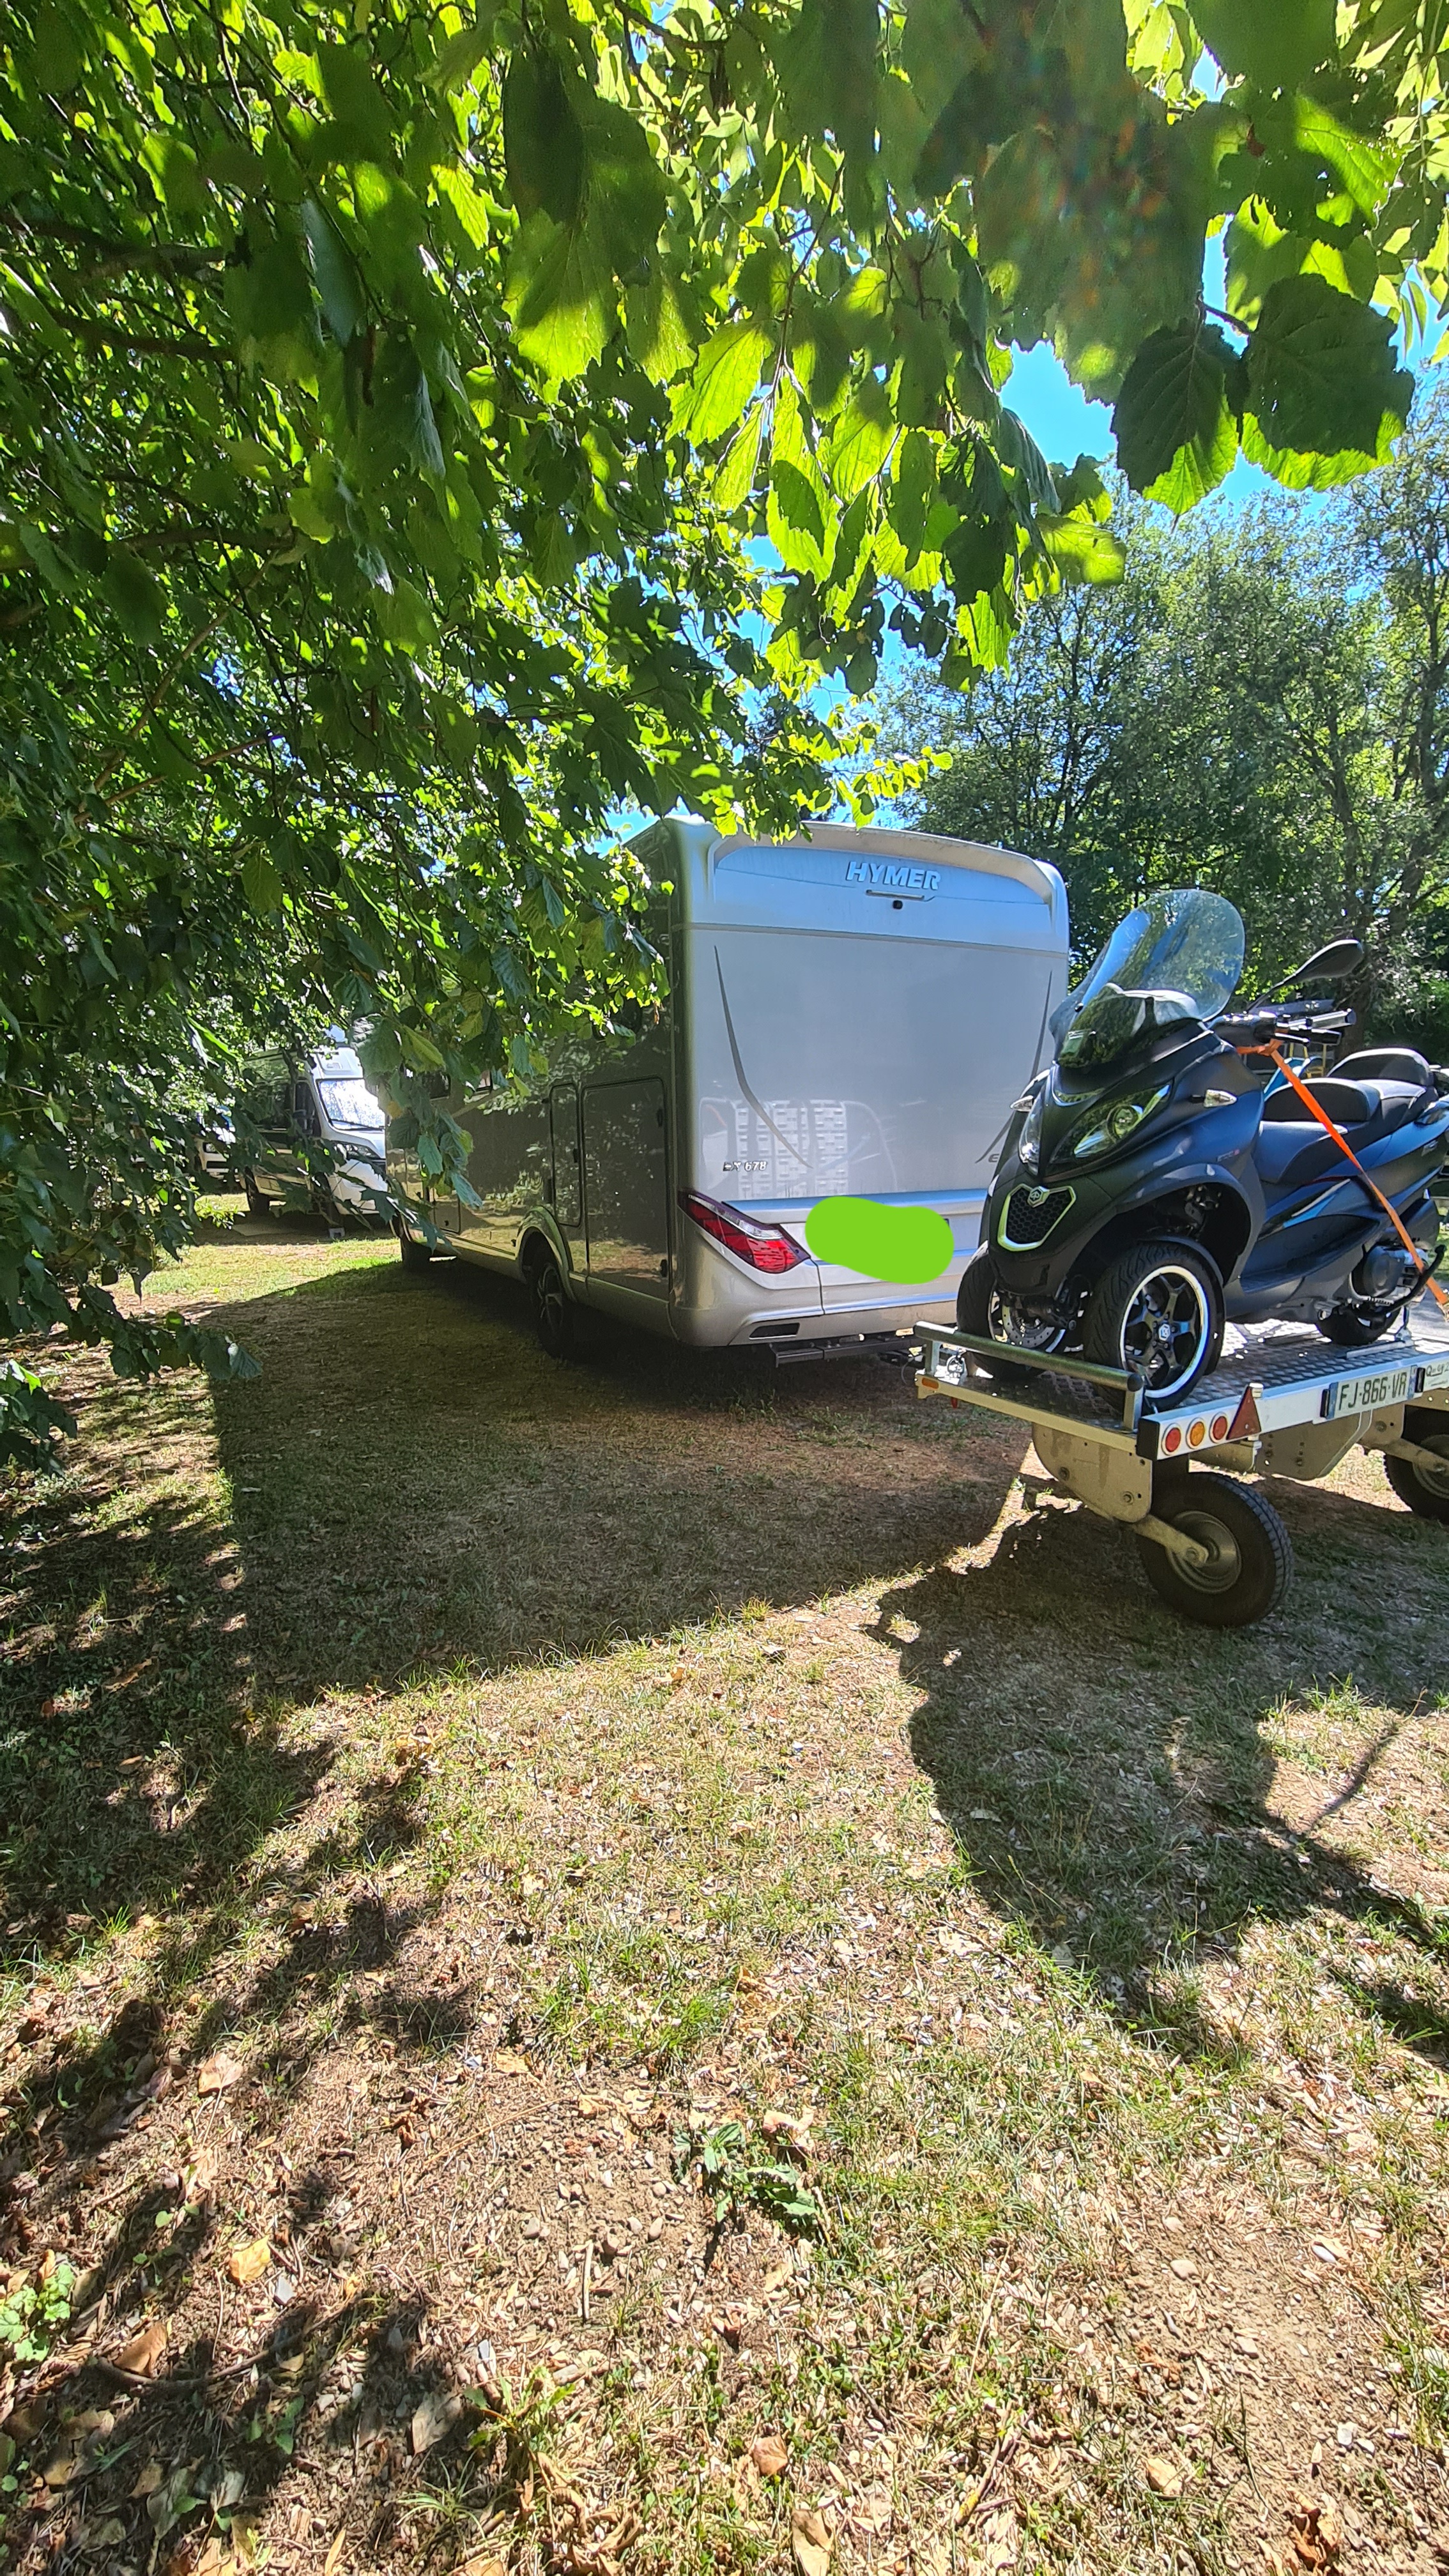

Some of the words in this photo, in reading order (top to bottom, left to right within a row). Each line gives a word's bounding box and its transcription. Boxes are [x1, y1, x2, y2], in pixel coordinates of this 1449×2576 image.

[845, 861, 941, 890] HYMER
[744, 1161, 768, 1172] 678
[1338, 1372, 1408, 1411] FJ-866-VR
